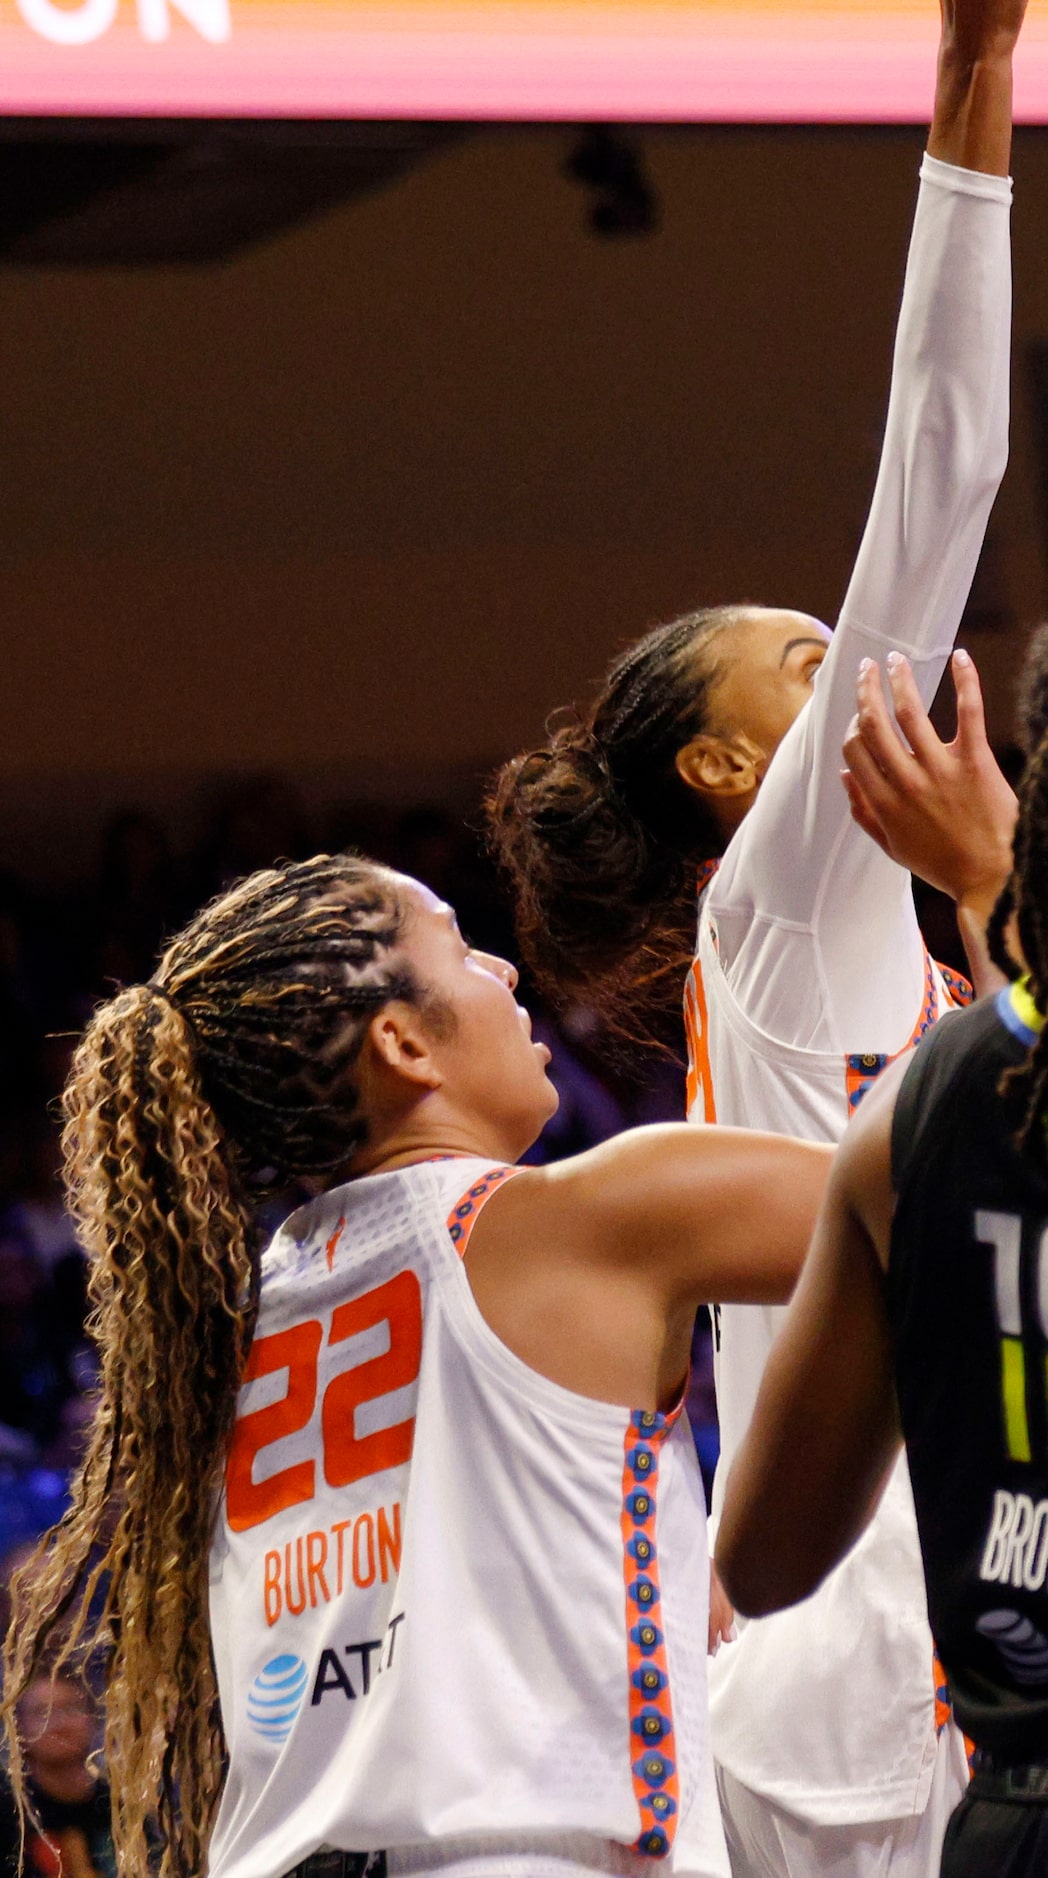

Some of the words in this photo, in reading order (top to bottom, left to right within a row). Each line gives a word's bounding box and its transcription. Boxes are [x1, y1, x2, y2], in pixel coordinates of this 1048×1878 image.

[226, 1269, 424, 1533] 22
[263, 1503, 401, 1627] BURTON
[311, 1611, 405, 1706] ATT
